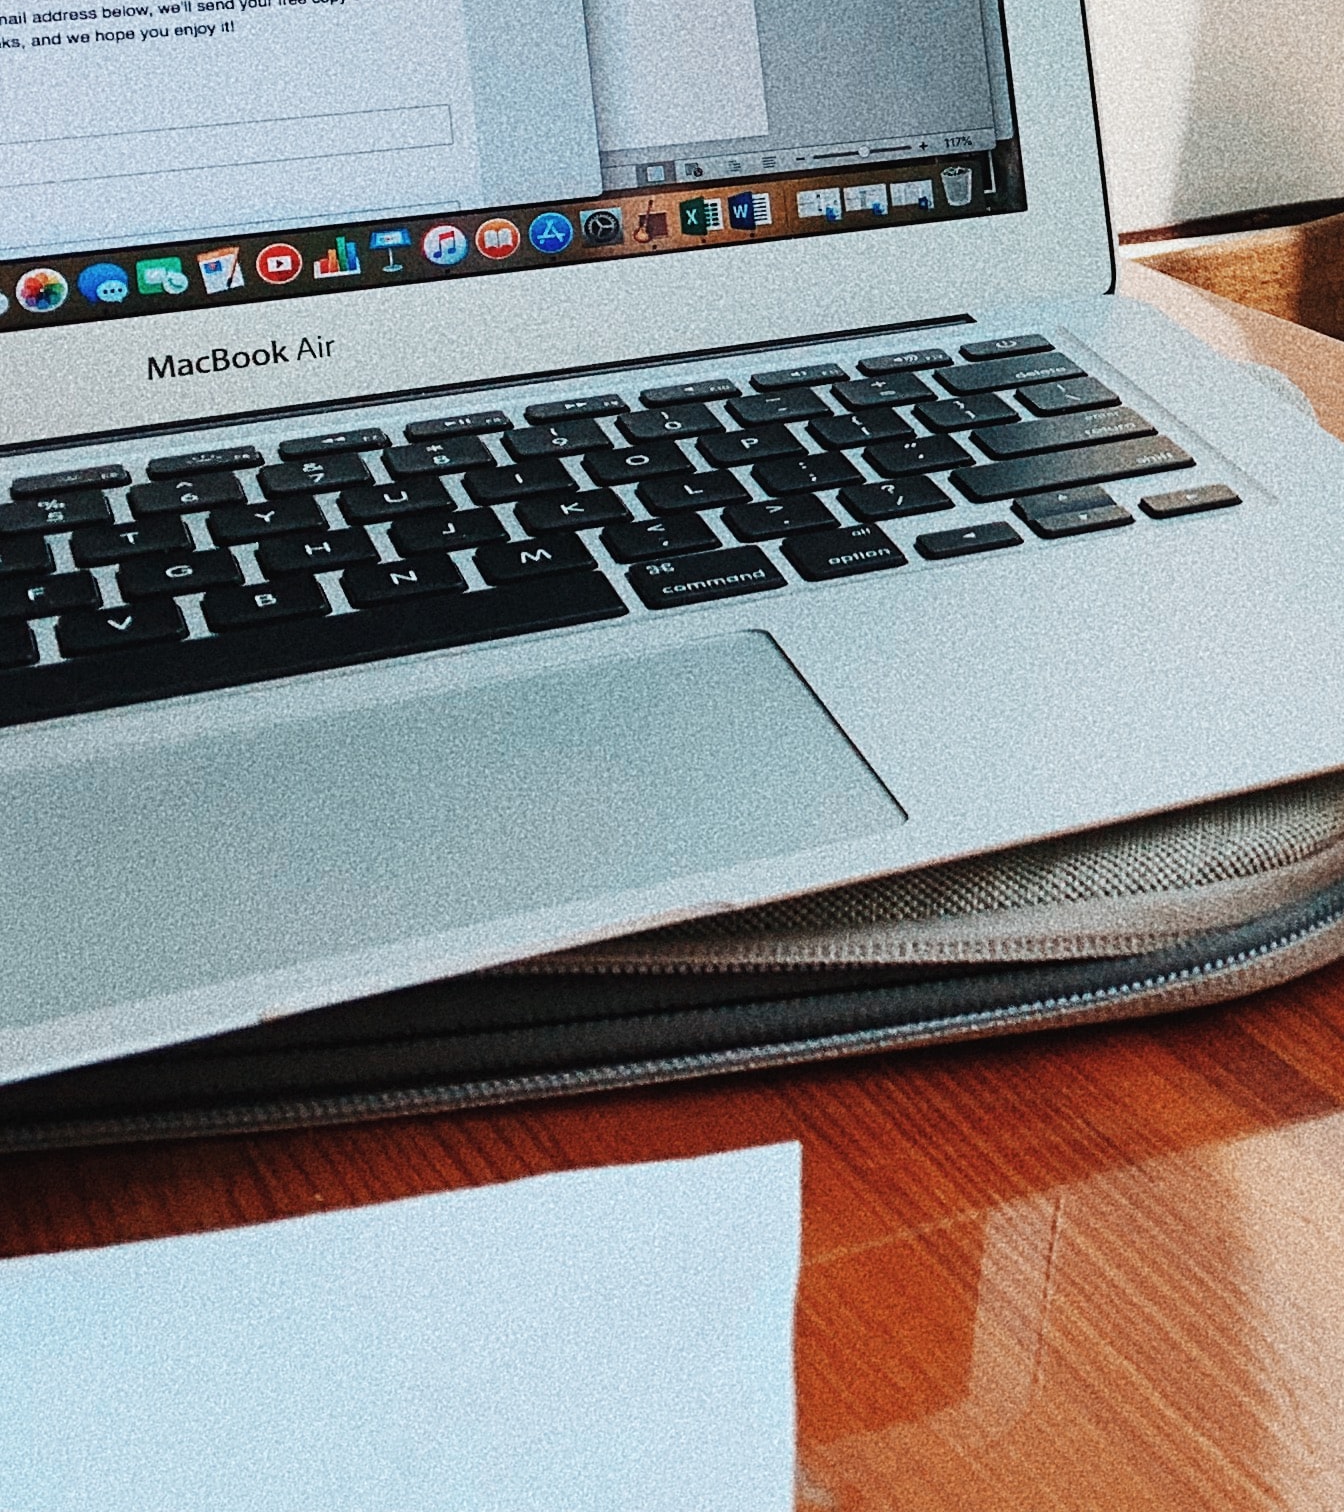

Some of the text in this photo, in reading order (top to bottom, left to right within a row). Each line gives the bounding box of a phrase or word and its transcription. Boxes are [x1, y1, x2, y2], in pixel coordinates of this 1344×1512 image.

[32, 6, 98, 24] address
[102, 4, 153, 19] below,
[157, 0, 192, 15] we'll
[31, 32, 62, 47] and
[67, 32, 90, 44] we
[95, 29, 136, 44] hope
[140, 26, 170, 41] you
[174, 23, 216, 38] enjoy
[221, 20, 235, 33] it!
[944, 135, 973, 149] 117%
[148, 336, 336, 381] MacBook Air
[1015, 366, 1067, 379] delete
[1083, 420, 1138, 437] return
[552, 437, 568, 447] 9
[740, 437, 759, 449] P
[433, 455, 450, 465] 8
[625, 454, 650, 466] O
[1136, 452, 1175, 464] shift
[306, 472, 325, 484] 7
[683, 484, 703, 495] L
[180, 493, 199, 503] 6
[383, 490, 408, 503] U
[560, 502, 584, 515] K
[255, 510, 275, 523] Y
[442, 522, 456, 535] J
[849, 525, 872, 538] alt
[119, 531, 139, 545] T
[304, 541, 331, 556] H
[520, 548, 552, 564] M
[828, 548, 891, 565] option
[165, 565, 193, 578] G
[390, 570, 418, 585] N
[662, 569, 767, 594] command
[254, 593, 277, 608] B
[107, 615, 132, 631] V
